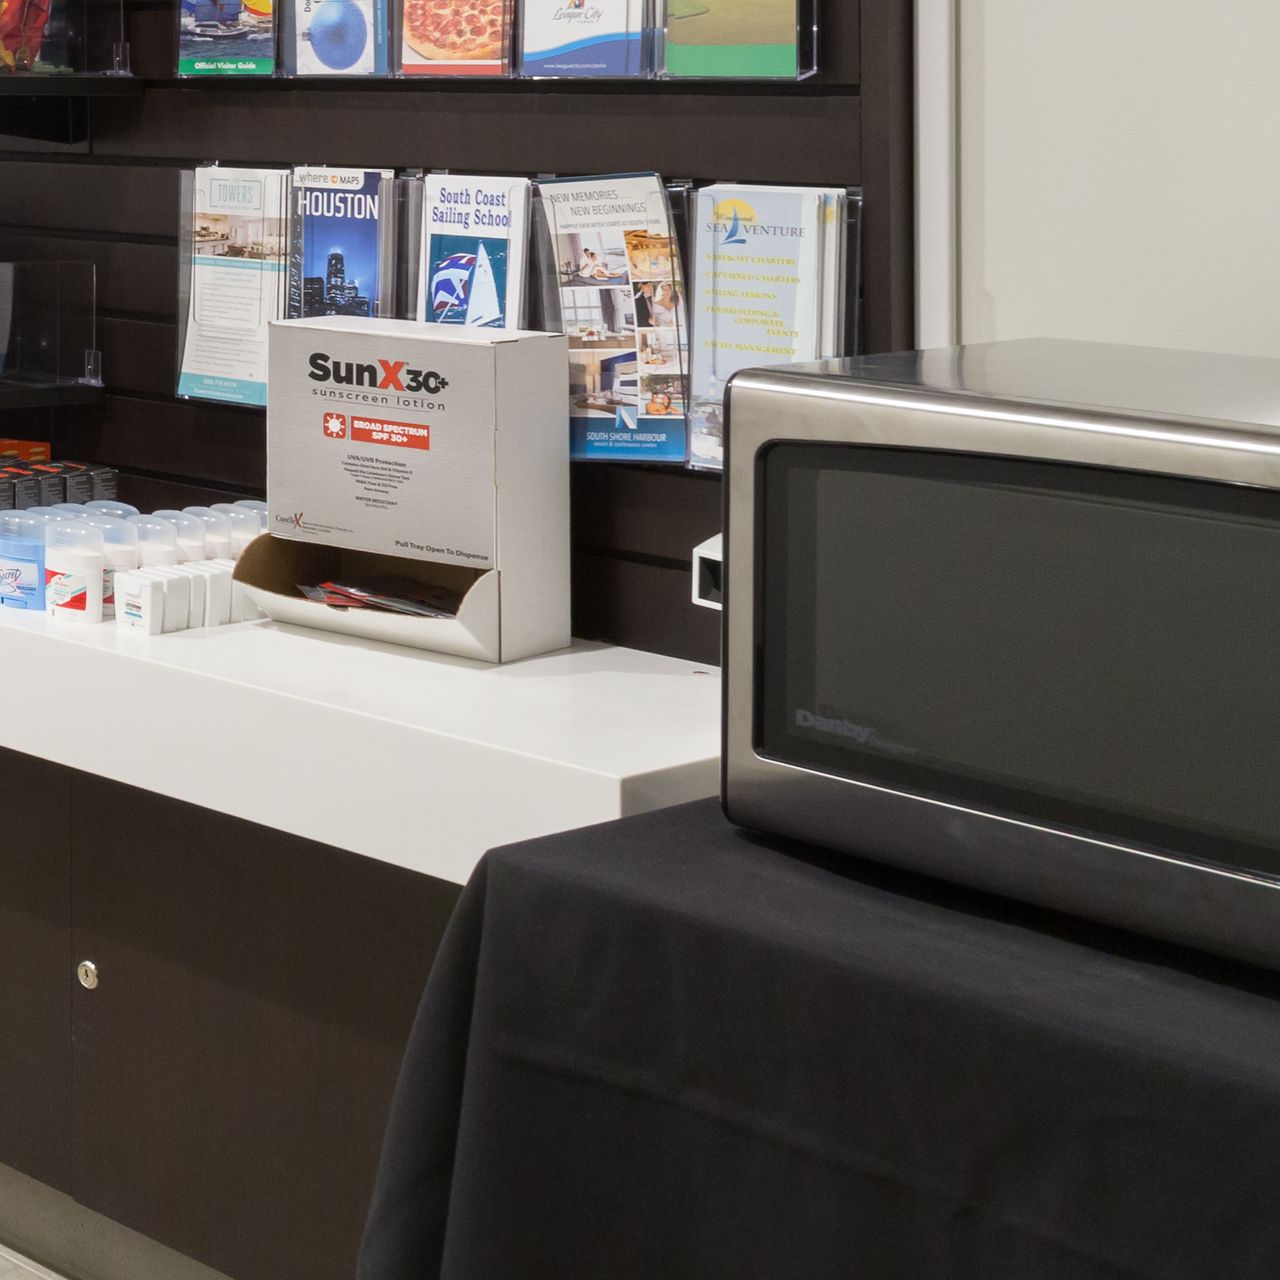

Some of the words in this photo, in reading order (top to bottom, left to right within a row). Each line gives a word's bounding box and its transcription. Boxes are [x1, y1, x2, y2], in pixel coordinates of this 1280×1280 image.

[552, 6, 584, 24] League
[584, 6, 604, 23] City
[194, 61, 217, 70] Official
[217, 61, 236, 70] Visitor
[237, 61, 256, 70] Guide
[299, 171, 329, 185] where
[339, 174, 360, 185] MAPS
[218, 183, 253, 204] TOWERS
[440, 187, 471, 206] South
[474, 188, 506, 208] Coast
[550, 192, 570, 204] NEW
[571, 190, 619, 202] MEMORIES
[297, 190, 378, 220] HOUSTON
[570, 205, 591, 216] NEW
[592, 202, 647, 216] BEGINNINGS
[432, 206, 469, 230] Sailing
[473, 208, 512, 228] School
[705, 222, 728, 234] SEA
[744, 224, 806, 238] VENTURE
[767, 328, 799, 338] EVENTS
[312, 387, 389, 405] sunscreen
[396, 396, 446, 411] lotion
[353, 420, 382, 432] BROAD
[383, 424, 428, 437] SPECTRUM
[586, 431, 608, 441] SOUTH
[609, 432, 631, 441] SHORE
[633, 433, 667, 442] HARBOUR
[371, 431, 389, 441] SPF
[391, 434, 408, 443] 30+
[347, 454, 375, 464] UVA/UVB
[375, 457, 407, 468] Protection
[394, 539, 409, 549] Pull
[410, 542, 425, 553] Tray
[425, 545, 446, 556] Open
[456, 548, 489, 562] Dispense
[795, 708, 875, 745] Danby
